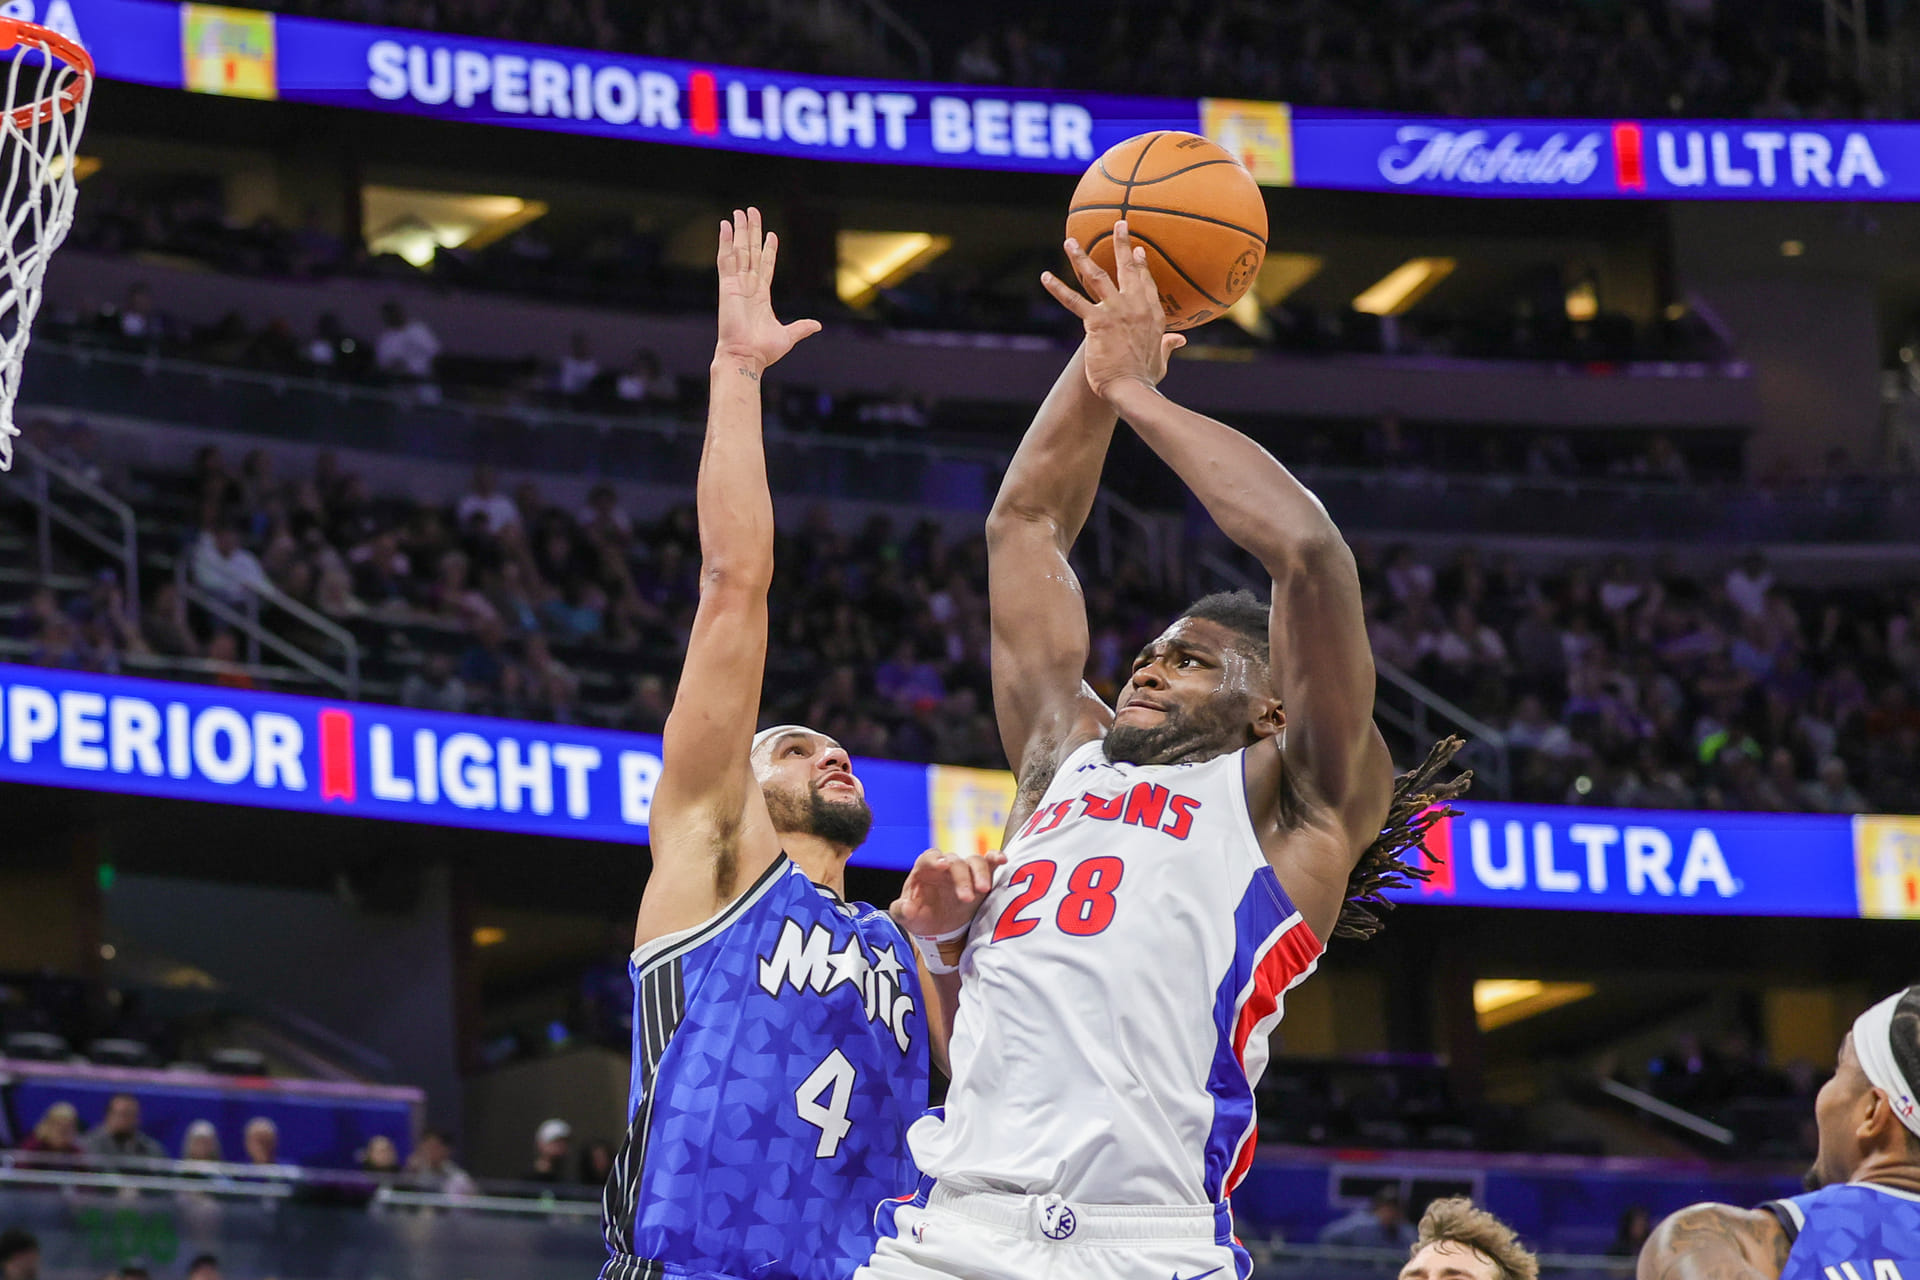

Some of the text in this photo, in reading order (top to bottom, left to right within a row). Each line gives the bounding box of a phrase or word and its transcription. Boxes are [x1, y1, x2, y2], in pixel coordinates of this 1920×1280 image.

[368, 41, 1095, 162] SUPERIOR LIGHT BEER
[1380, 126, 1885, 188] Michelob ULTRA
[0, 686, 306, 792] PERIOR
[370, 724, 600, 820] LIGHT
[991, 855, 1125, 945] 28
[1470, 818, 1737, 898] ULTRA
[795, 1047, 857, 1158] 4
